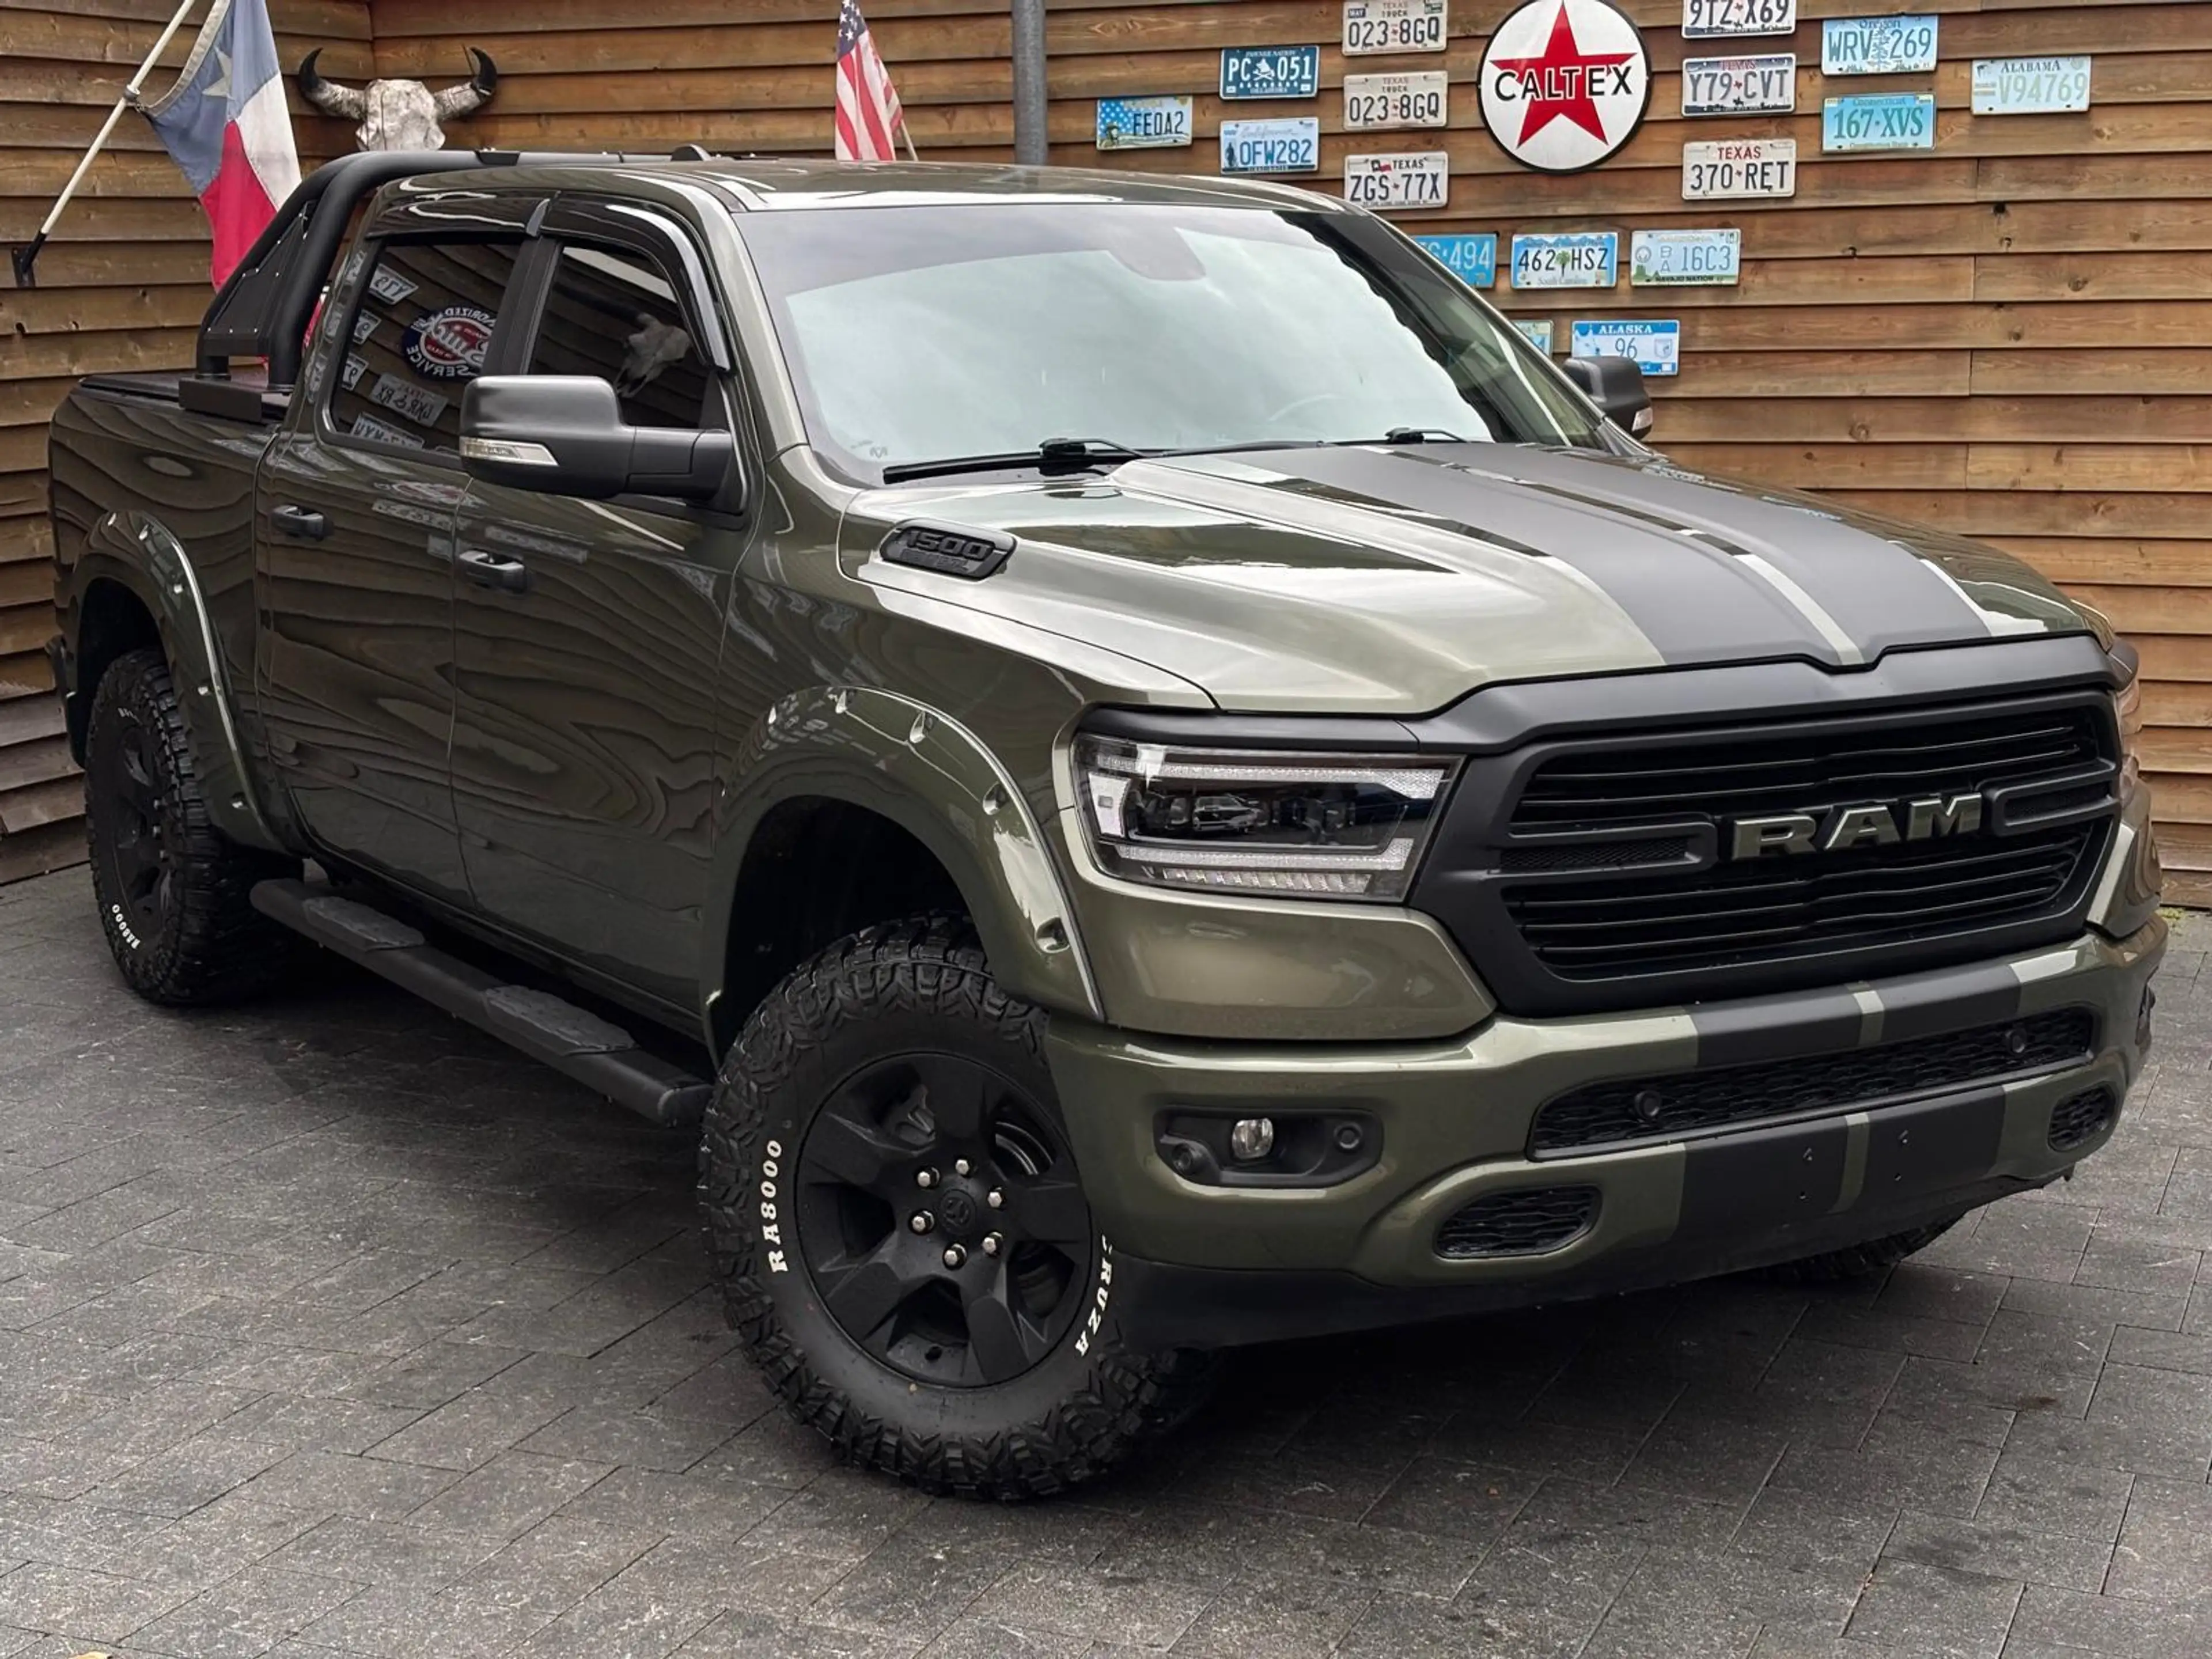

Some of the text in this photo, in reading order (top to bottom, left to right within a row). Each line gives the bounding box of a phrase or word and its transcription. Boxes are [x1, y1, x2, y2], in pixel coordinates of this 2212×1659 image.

[1349, 16, 1440, 47] 023 8GQ
[1828, 27, 1931, 62] WRV 269
[1228, 55, 1312, 82] PC 051
[2000, 60, 2061, 73] ALABAMA
[1494, 65, 1633, 101] CALTEX
[1689, 69, 1789, 102] Y79 CVT
[1998, 72, 2088, 104] V94769
[1349, 92, 1440, 122] 023 8GQ
[1392, 158, 1425, 169] TEXAS
[1717, 145, 1762, 161] TEXAS
[1350, 172, 1440, 202] ZGS 77X
[1690, 161, 1789, 191] 370 RET
[1518, 247, 1609, 271] 462 HSZ
[1681, 245, 1731, 271] 16C3
[1599, 324, 1653, 335] ALASKA
[907, 530, 991, 560] 1500
[1732, 791, 1982, 860] RAM
[760, 1139, 789, 1273] RA8000
